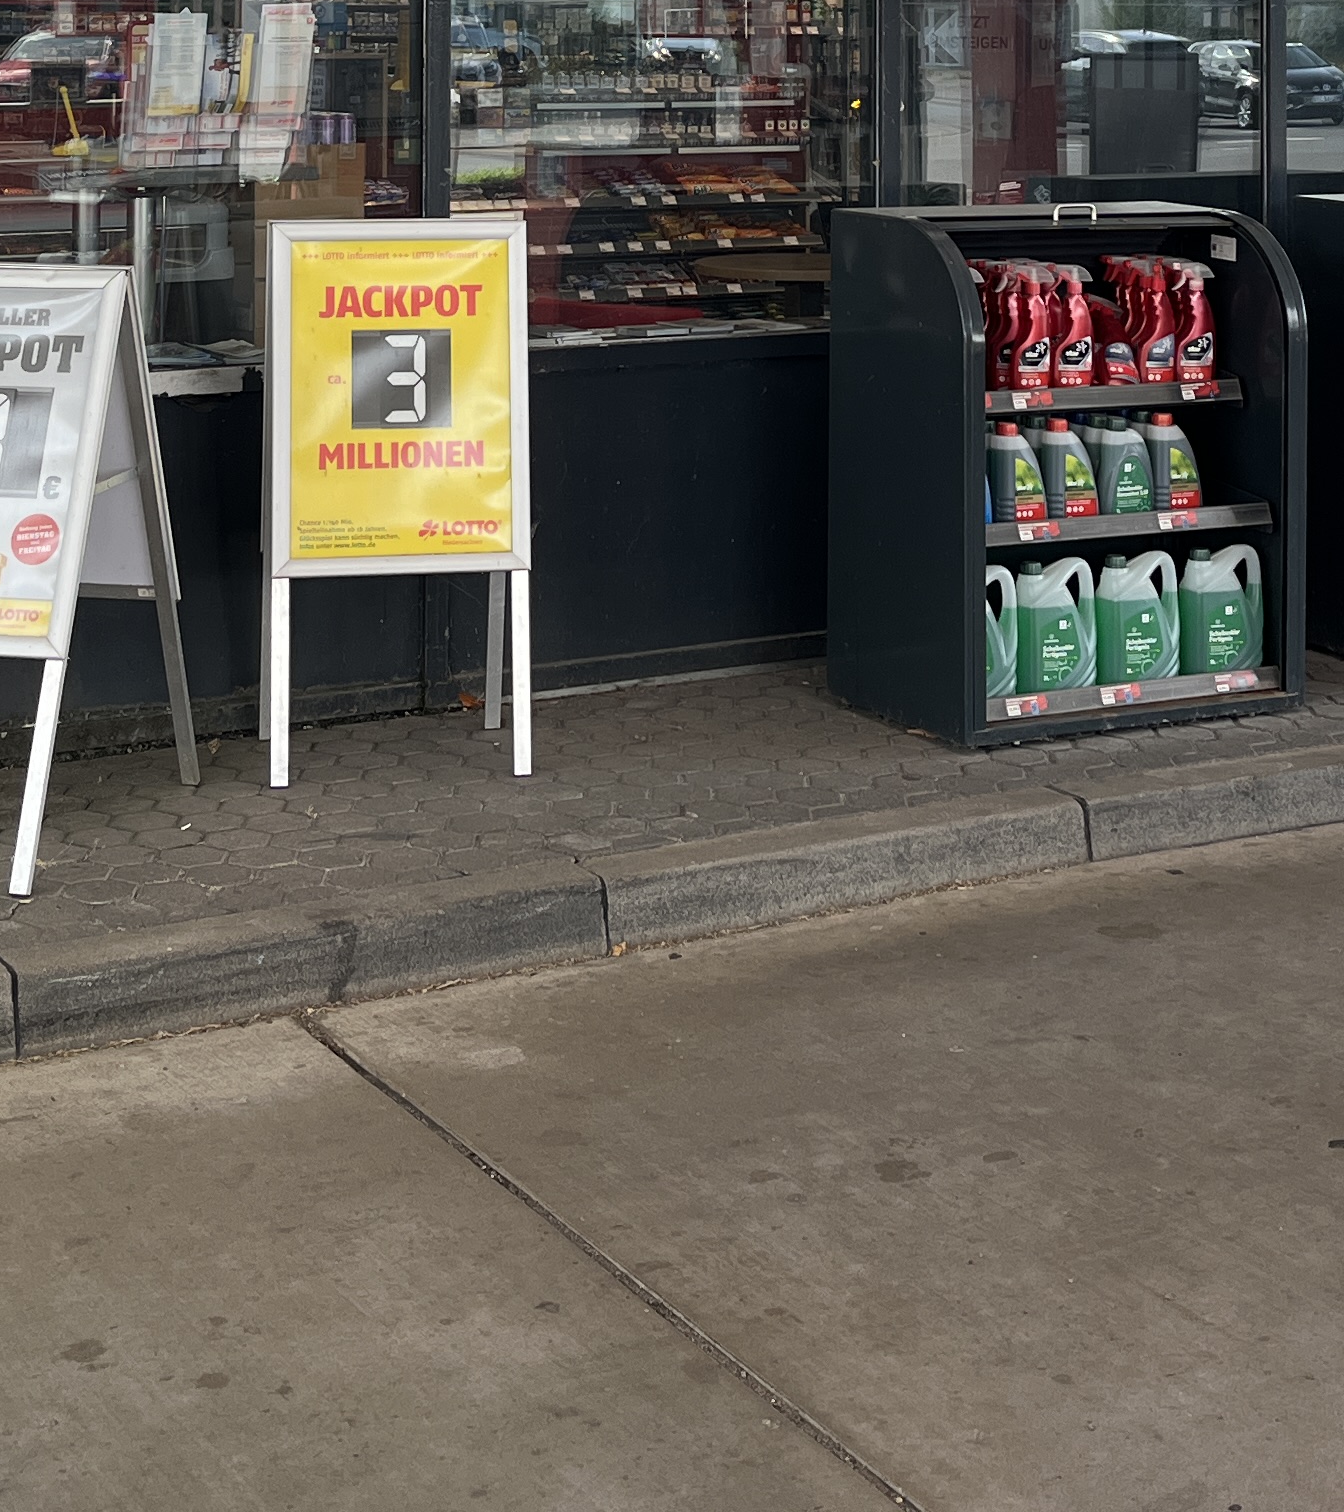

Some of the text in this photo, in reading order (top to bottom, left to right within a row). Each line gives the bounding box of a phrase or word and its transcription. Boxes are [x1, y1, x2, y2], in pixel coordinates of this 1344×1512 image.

[322, 252, 344, 261] LOTTO
[347, 252, 390, 260] informiert
[318, 284, 483, 319] JACKPOT
[327, 375, 346, 385] ca.
[385, 335, 426, 423] 3
[318, 440, 485, 470] MILLIONEN
[42, 476, 61, 500] €
[442, 519, 498, 536] LOTTO
